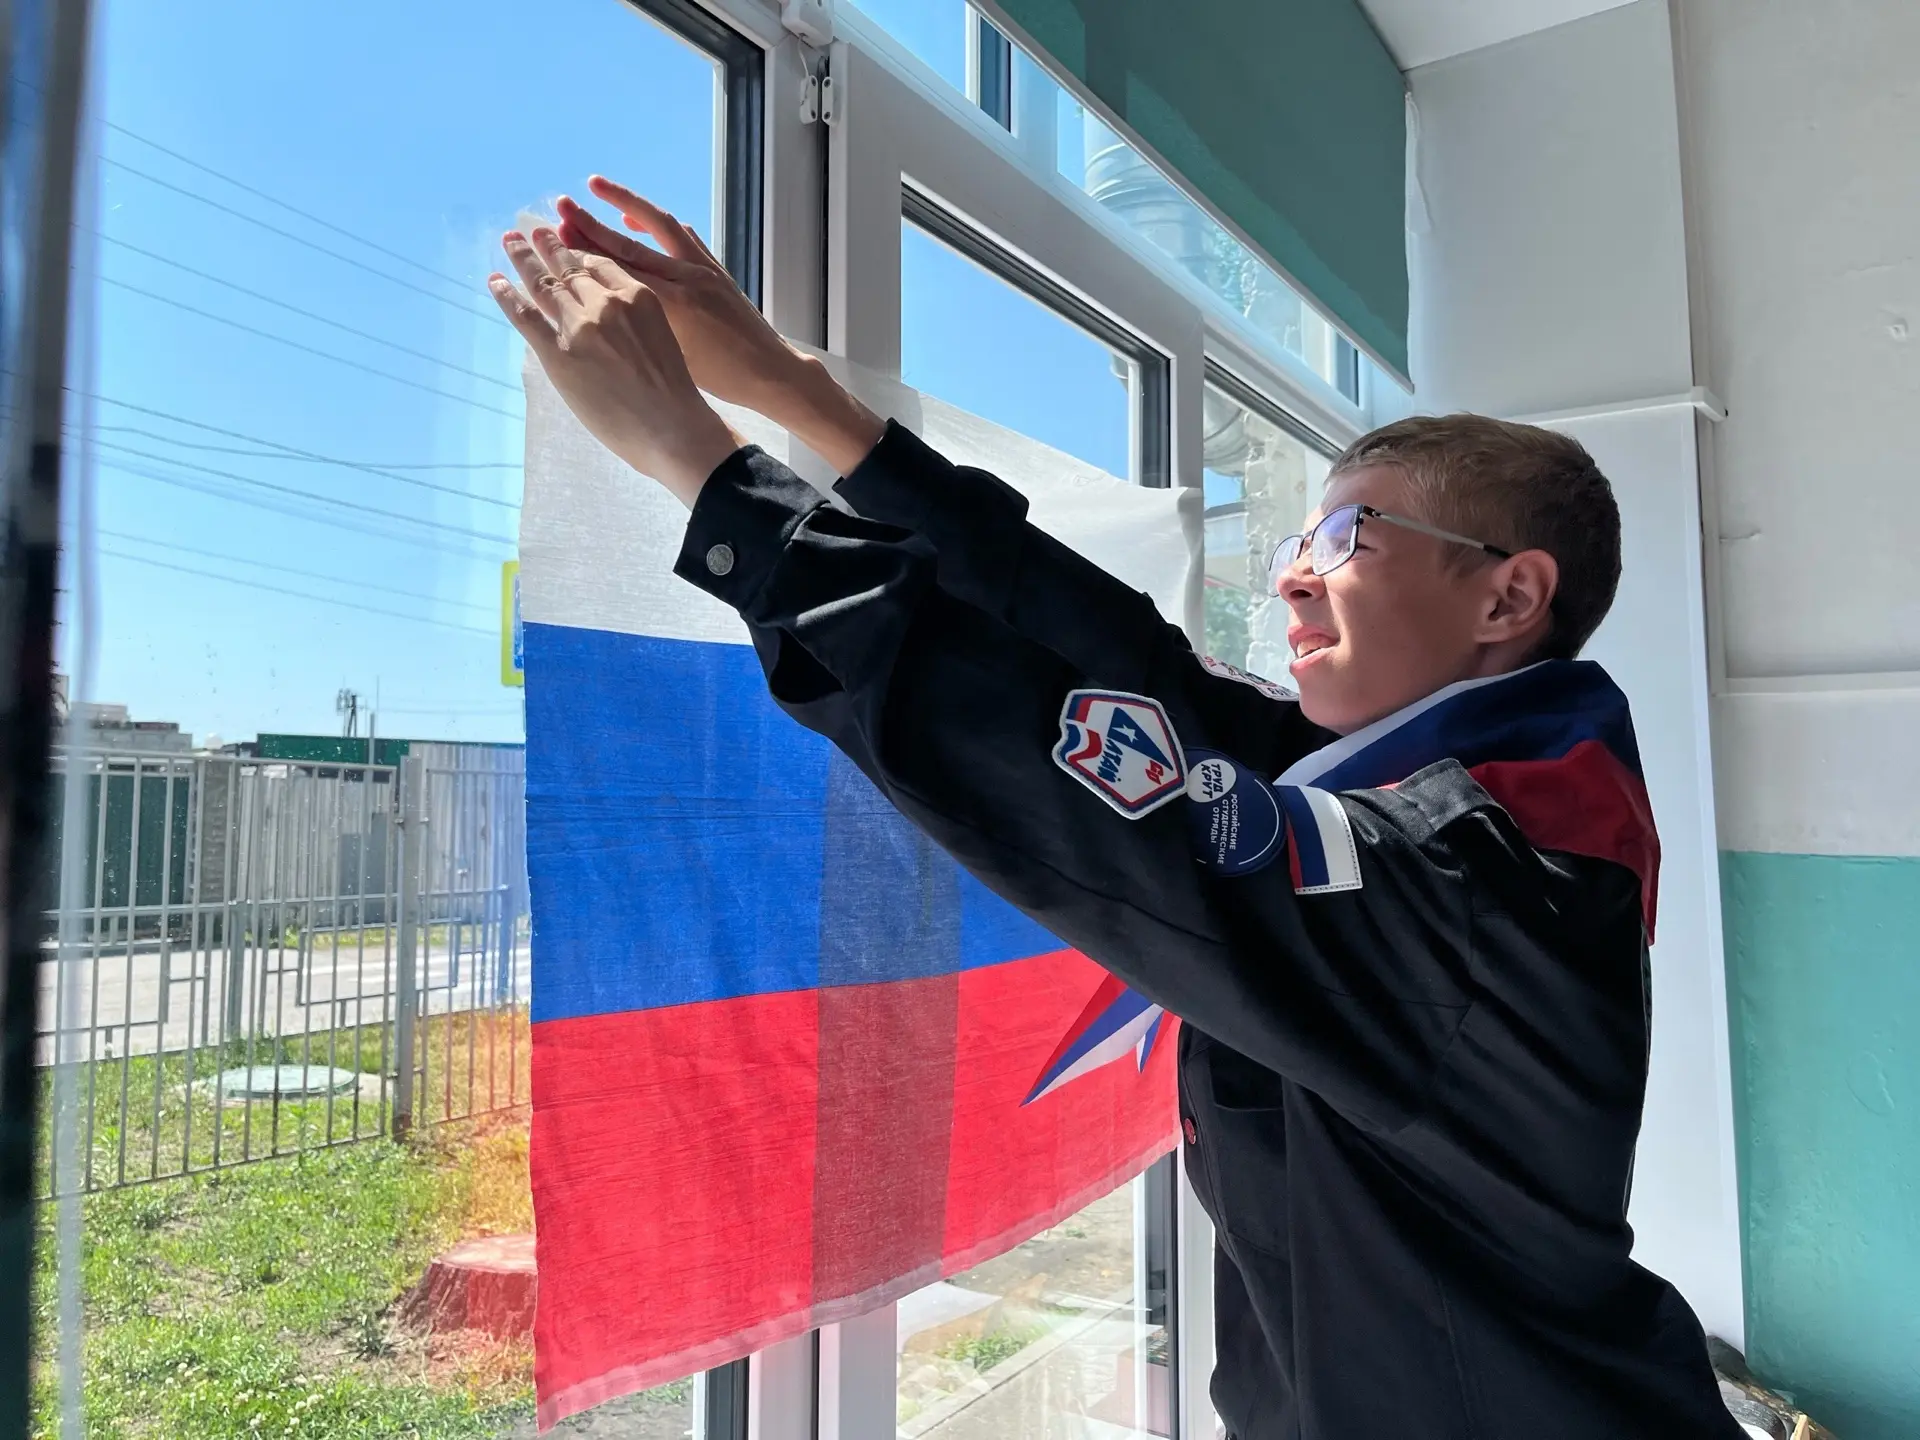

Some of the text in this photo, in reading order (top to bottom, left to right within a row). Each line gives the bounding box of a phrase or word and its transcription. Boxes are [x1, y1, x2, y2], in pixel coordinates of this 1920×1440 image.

[1201, 763, 1213, 799] КРУТ
[1211, 763, 1224, 793] ТРУД
[1210, 806, 1220, 843] ОТРЯДЫ
[1217, 799, 1229, 865] СТУДЕНЧЕСКИЕ
[1229, 793, 1240, 850] РОССИЙСКИЕ
